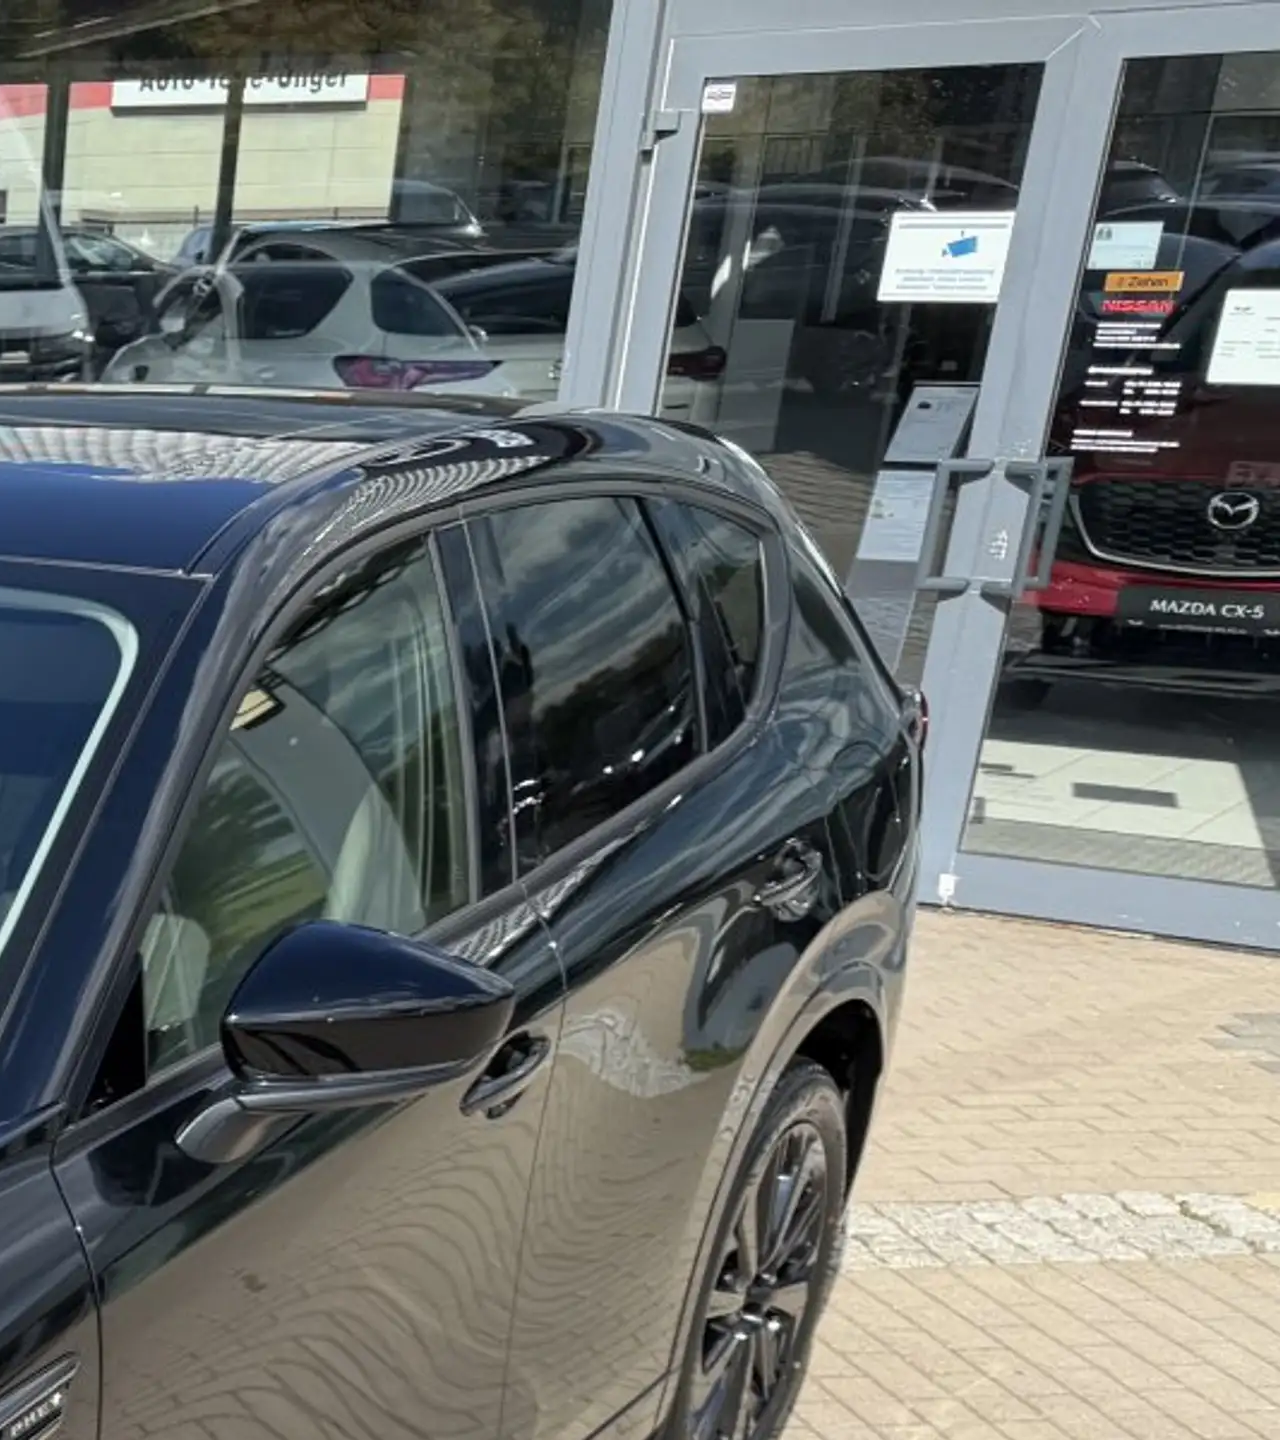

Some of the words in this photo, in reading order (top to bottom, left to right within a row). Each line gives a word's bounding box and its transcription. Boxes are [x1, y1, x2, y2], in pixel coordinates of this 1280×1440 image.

[1101, 299, 1174, 314] NISSAN
[1149, 599, 1217, 617] MAZDA
[1220, 604, 1265, 620] CX-5
